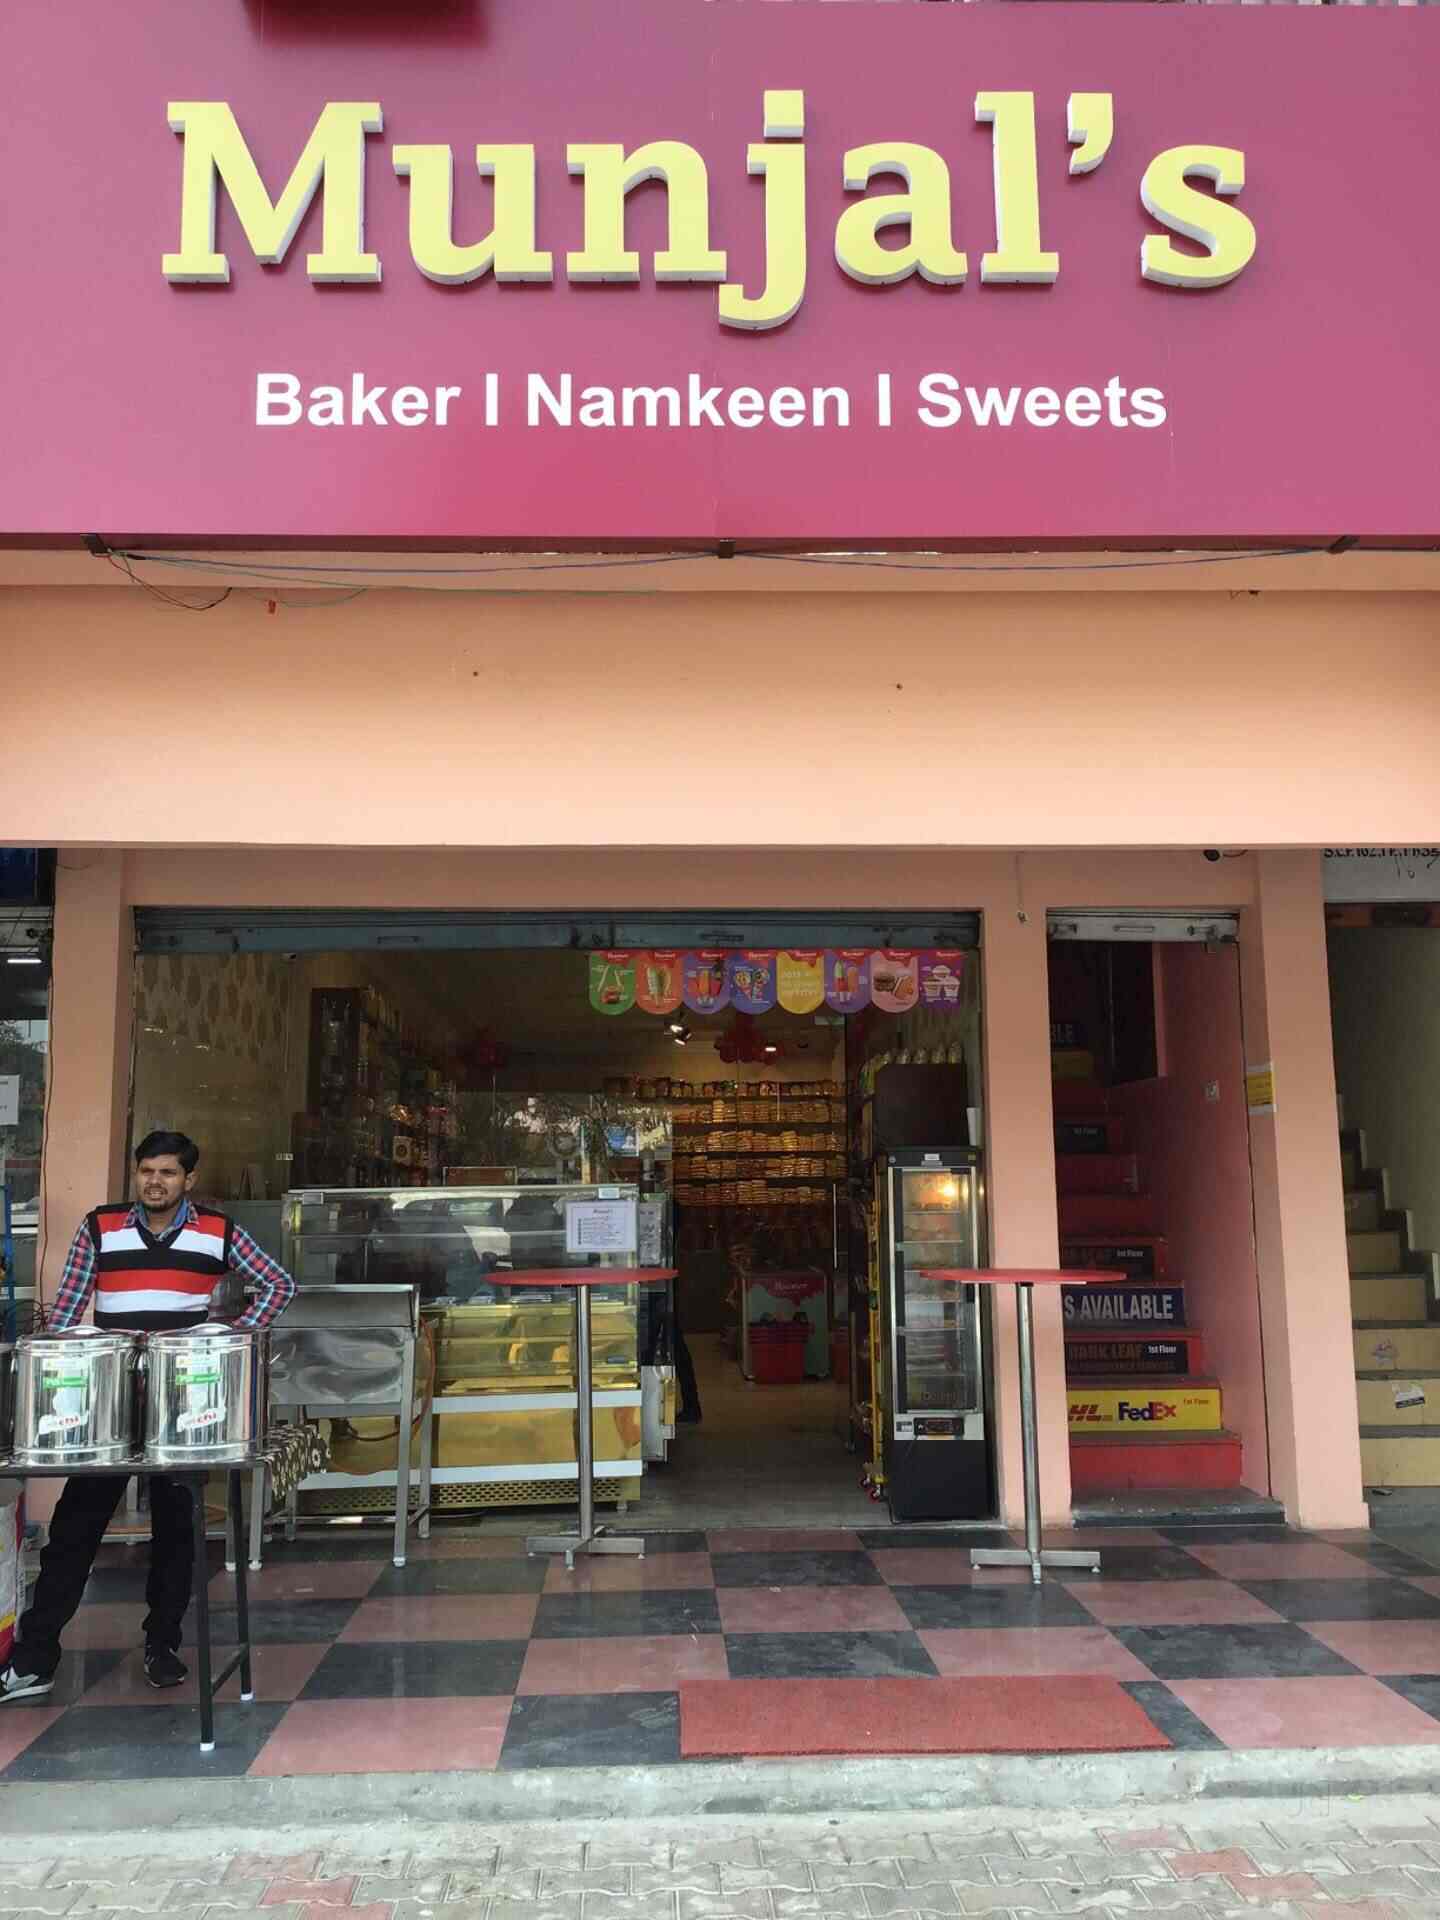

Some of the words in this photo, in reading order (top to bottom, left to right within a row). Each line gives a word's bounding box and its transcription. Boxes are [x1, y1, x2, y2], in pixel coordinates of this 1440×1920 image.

[256, 373, 462, 426] Baker
[527, 373, 850, 427] Namkeen
[917, 372, 1168, 428] Sweets
[1080, 1294, 1174, 1320] AVAILABLE
[1148, 1345, 1158, 1354] 1st
[1159, 1345, 1177, 1354] Floor
[1118, 1401, 1177, 1421] FedEx
